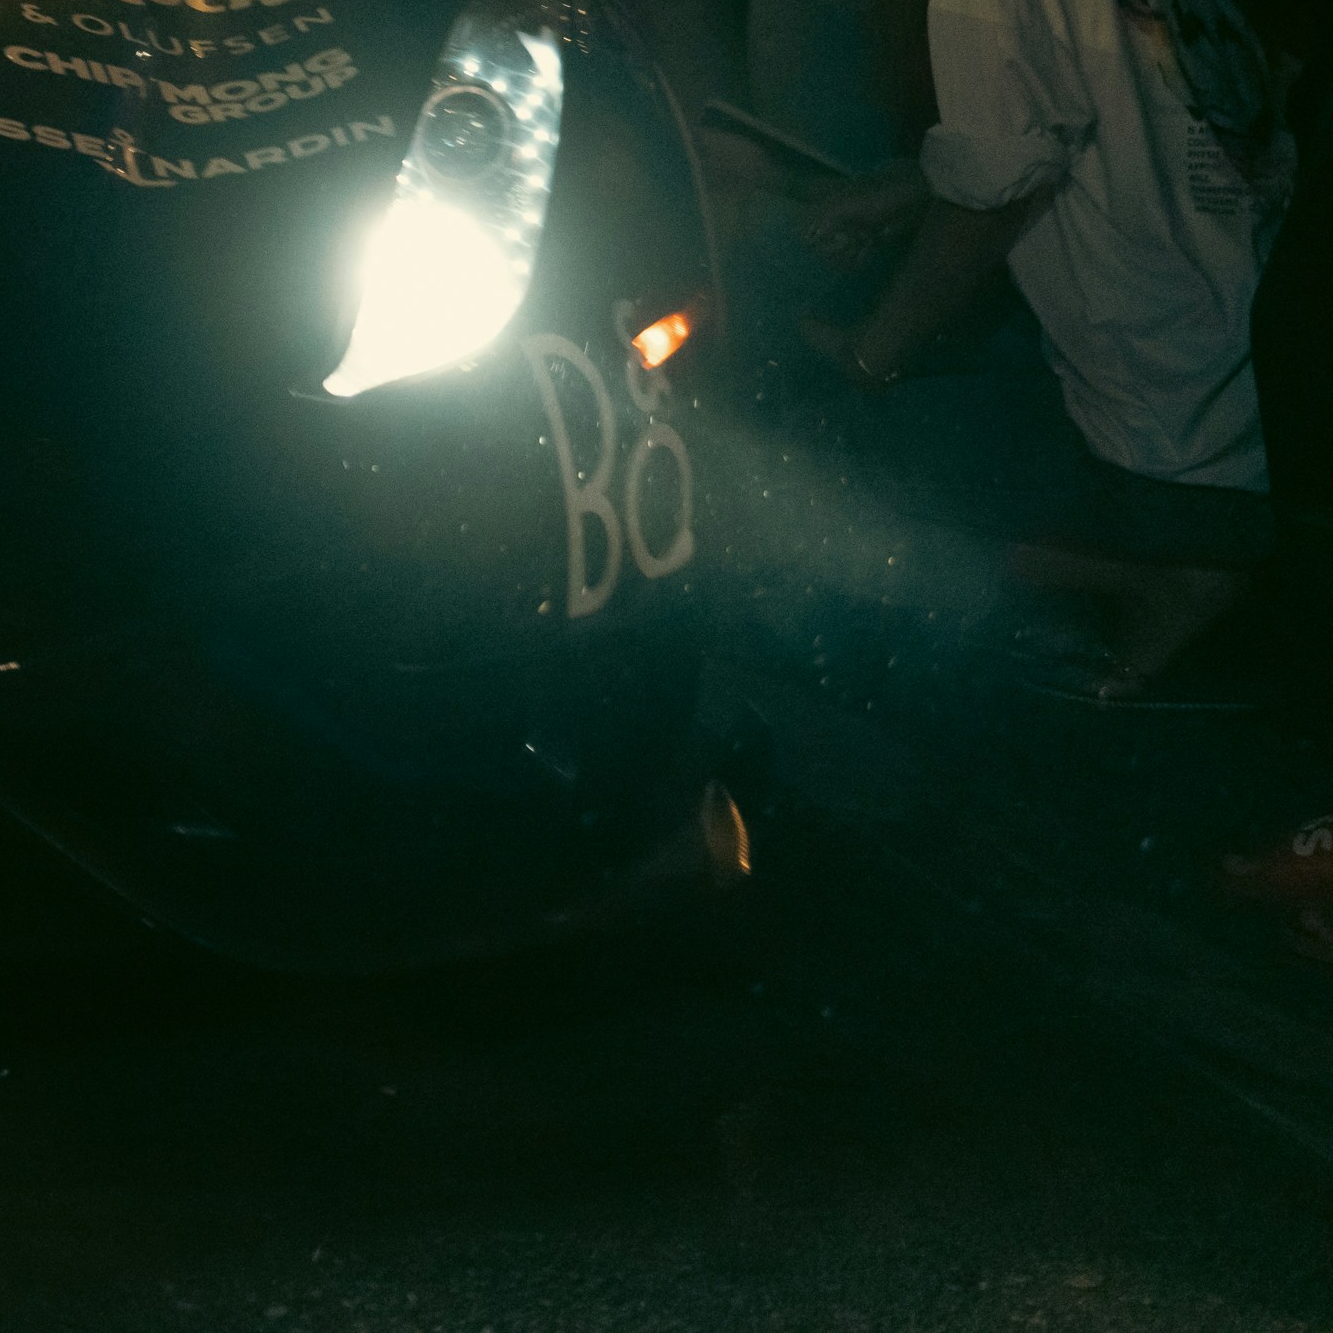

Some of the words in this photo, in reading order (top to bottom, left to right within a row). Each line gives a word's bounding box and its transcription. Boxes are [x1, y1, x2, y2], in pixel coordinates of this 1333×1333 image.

[21, 4, 59, 26] &
[72, 6, 335, 58] OLUFSEN
[3, 45, 147, 99] CHIP
[147, 47, 352, 105] MONG
[168, 65, 358, 125] GROUP
[149, 115, 396, 179] NARDIN
